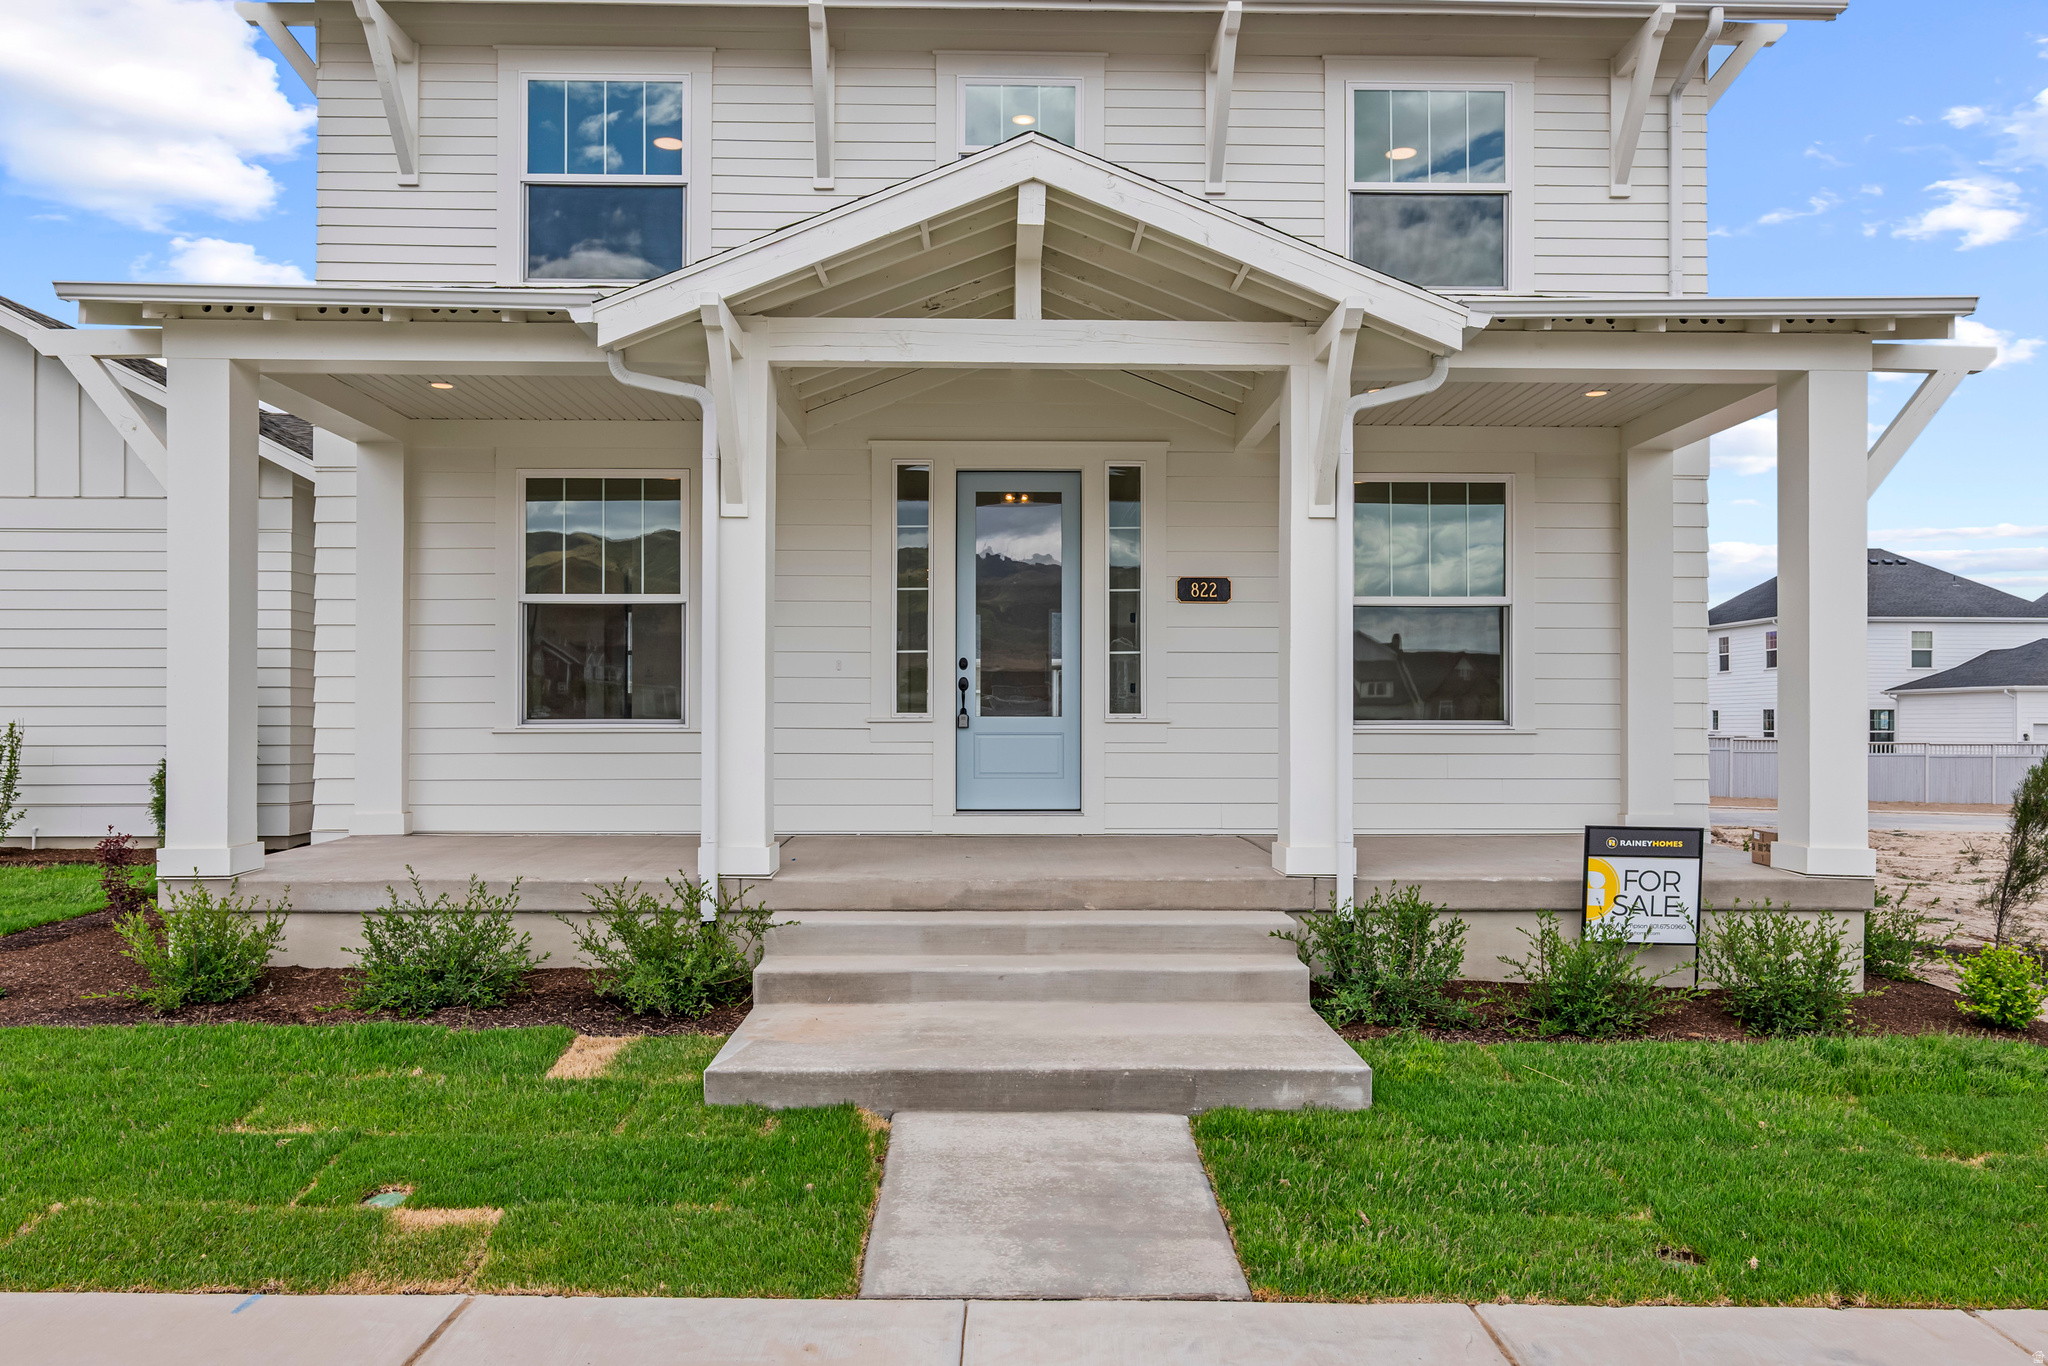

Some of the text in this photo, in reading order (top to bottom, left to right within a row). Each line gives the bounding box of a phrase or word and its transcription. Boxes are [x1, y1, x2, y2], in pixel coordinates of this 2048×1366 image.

[1190, 581, 1218, 598] 822
[1620, 839, 1683, 848] RAINEYHOMES
[1624, 869, 1681, 892] FOR
[1611, 894, 1680, 917] SALE
